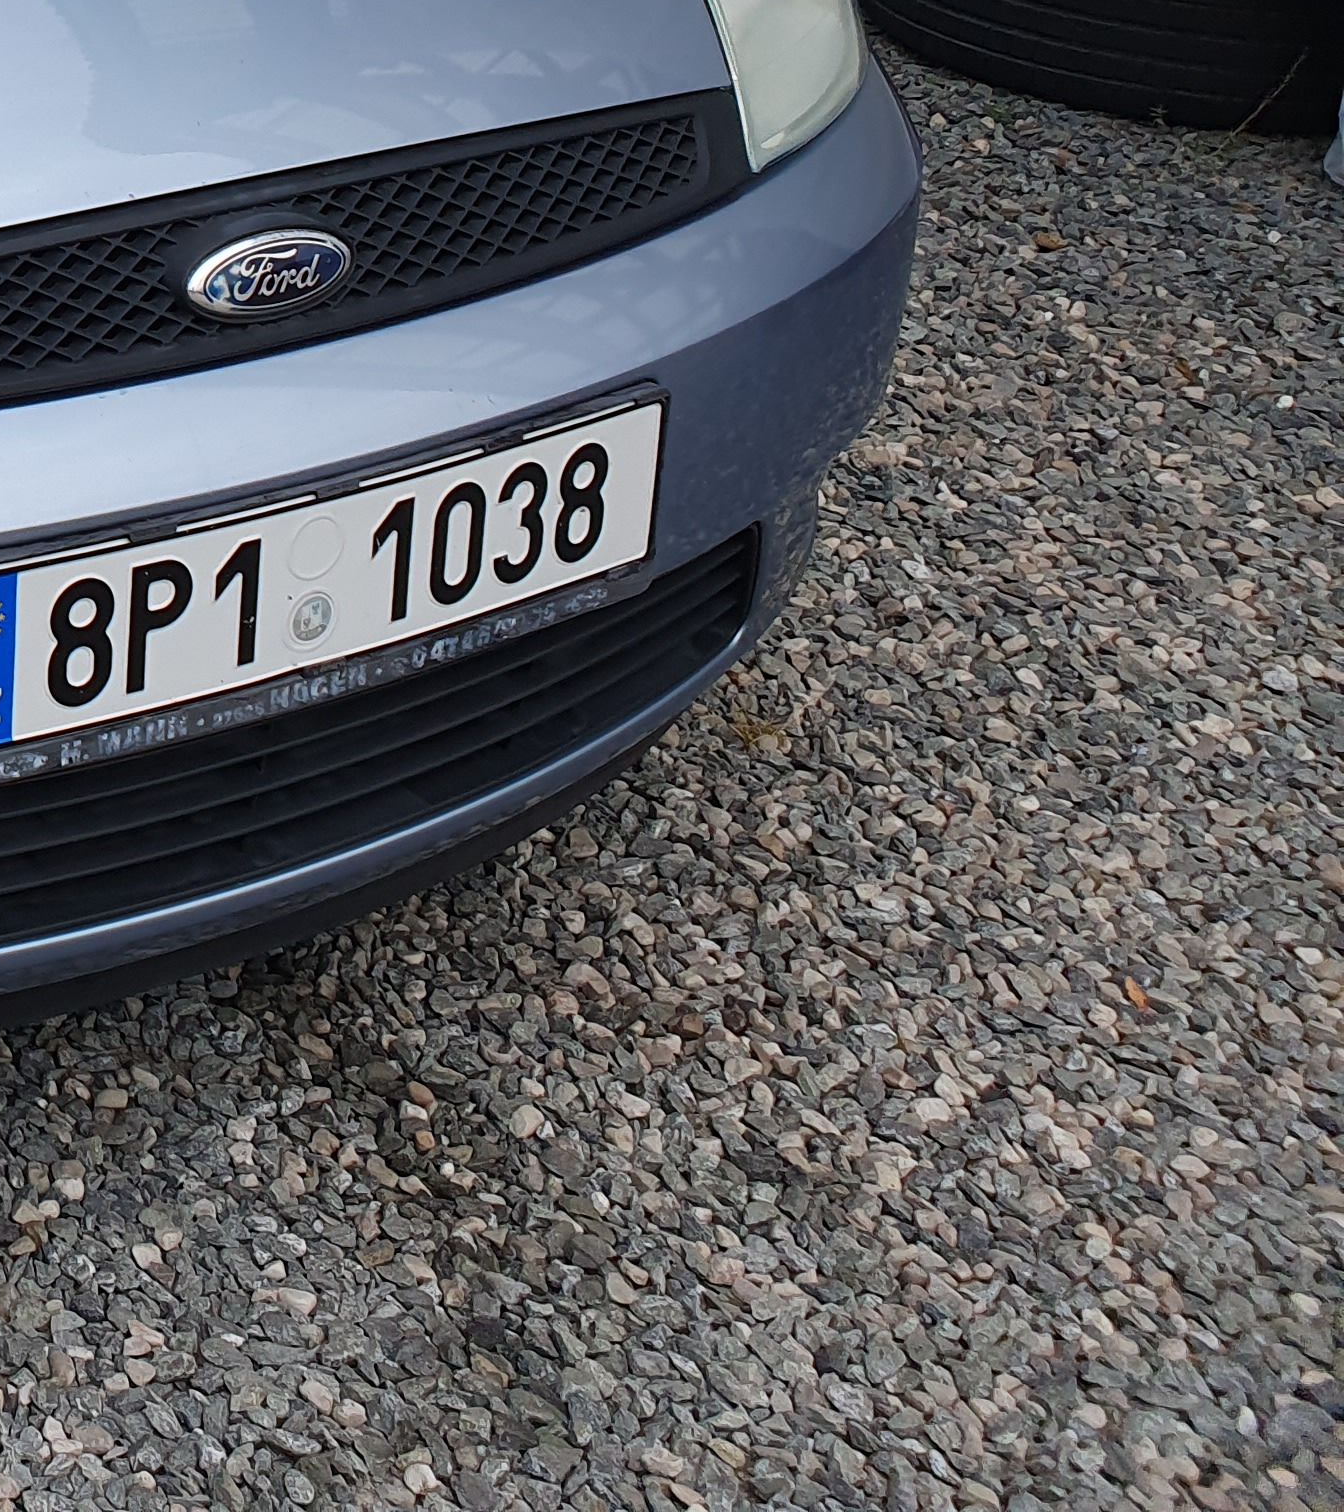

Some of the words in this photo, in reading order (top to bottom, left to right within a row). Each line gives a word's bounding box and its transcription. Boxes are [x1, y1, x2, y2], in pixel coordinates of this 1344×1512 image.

[232, 247, 320, 302] Ford
[46, 537, 263, 708] 8P1
[370, 441, 610, 624] 1038
